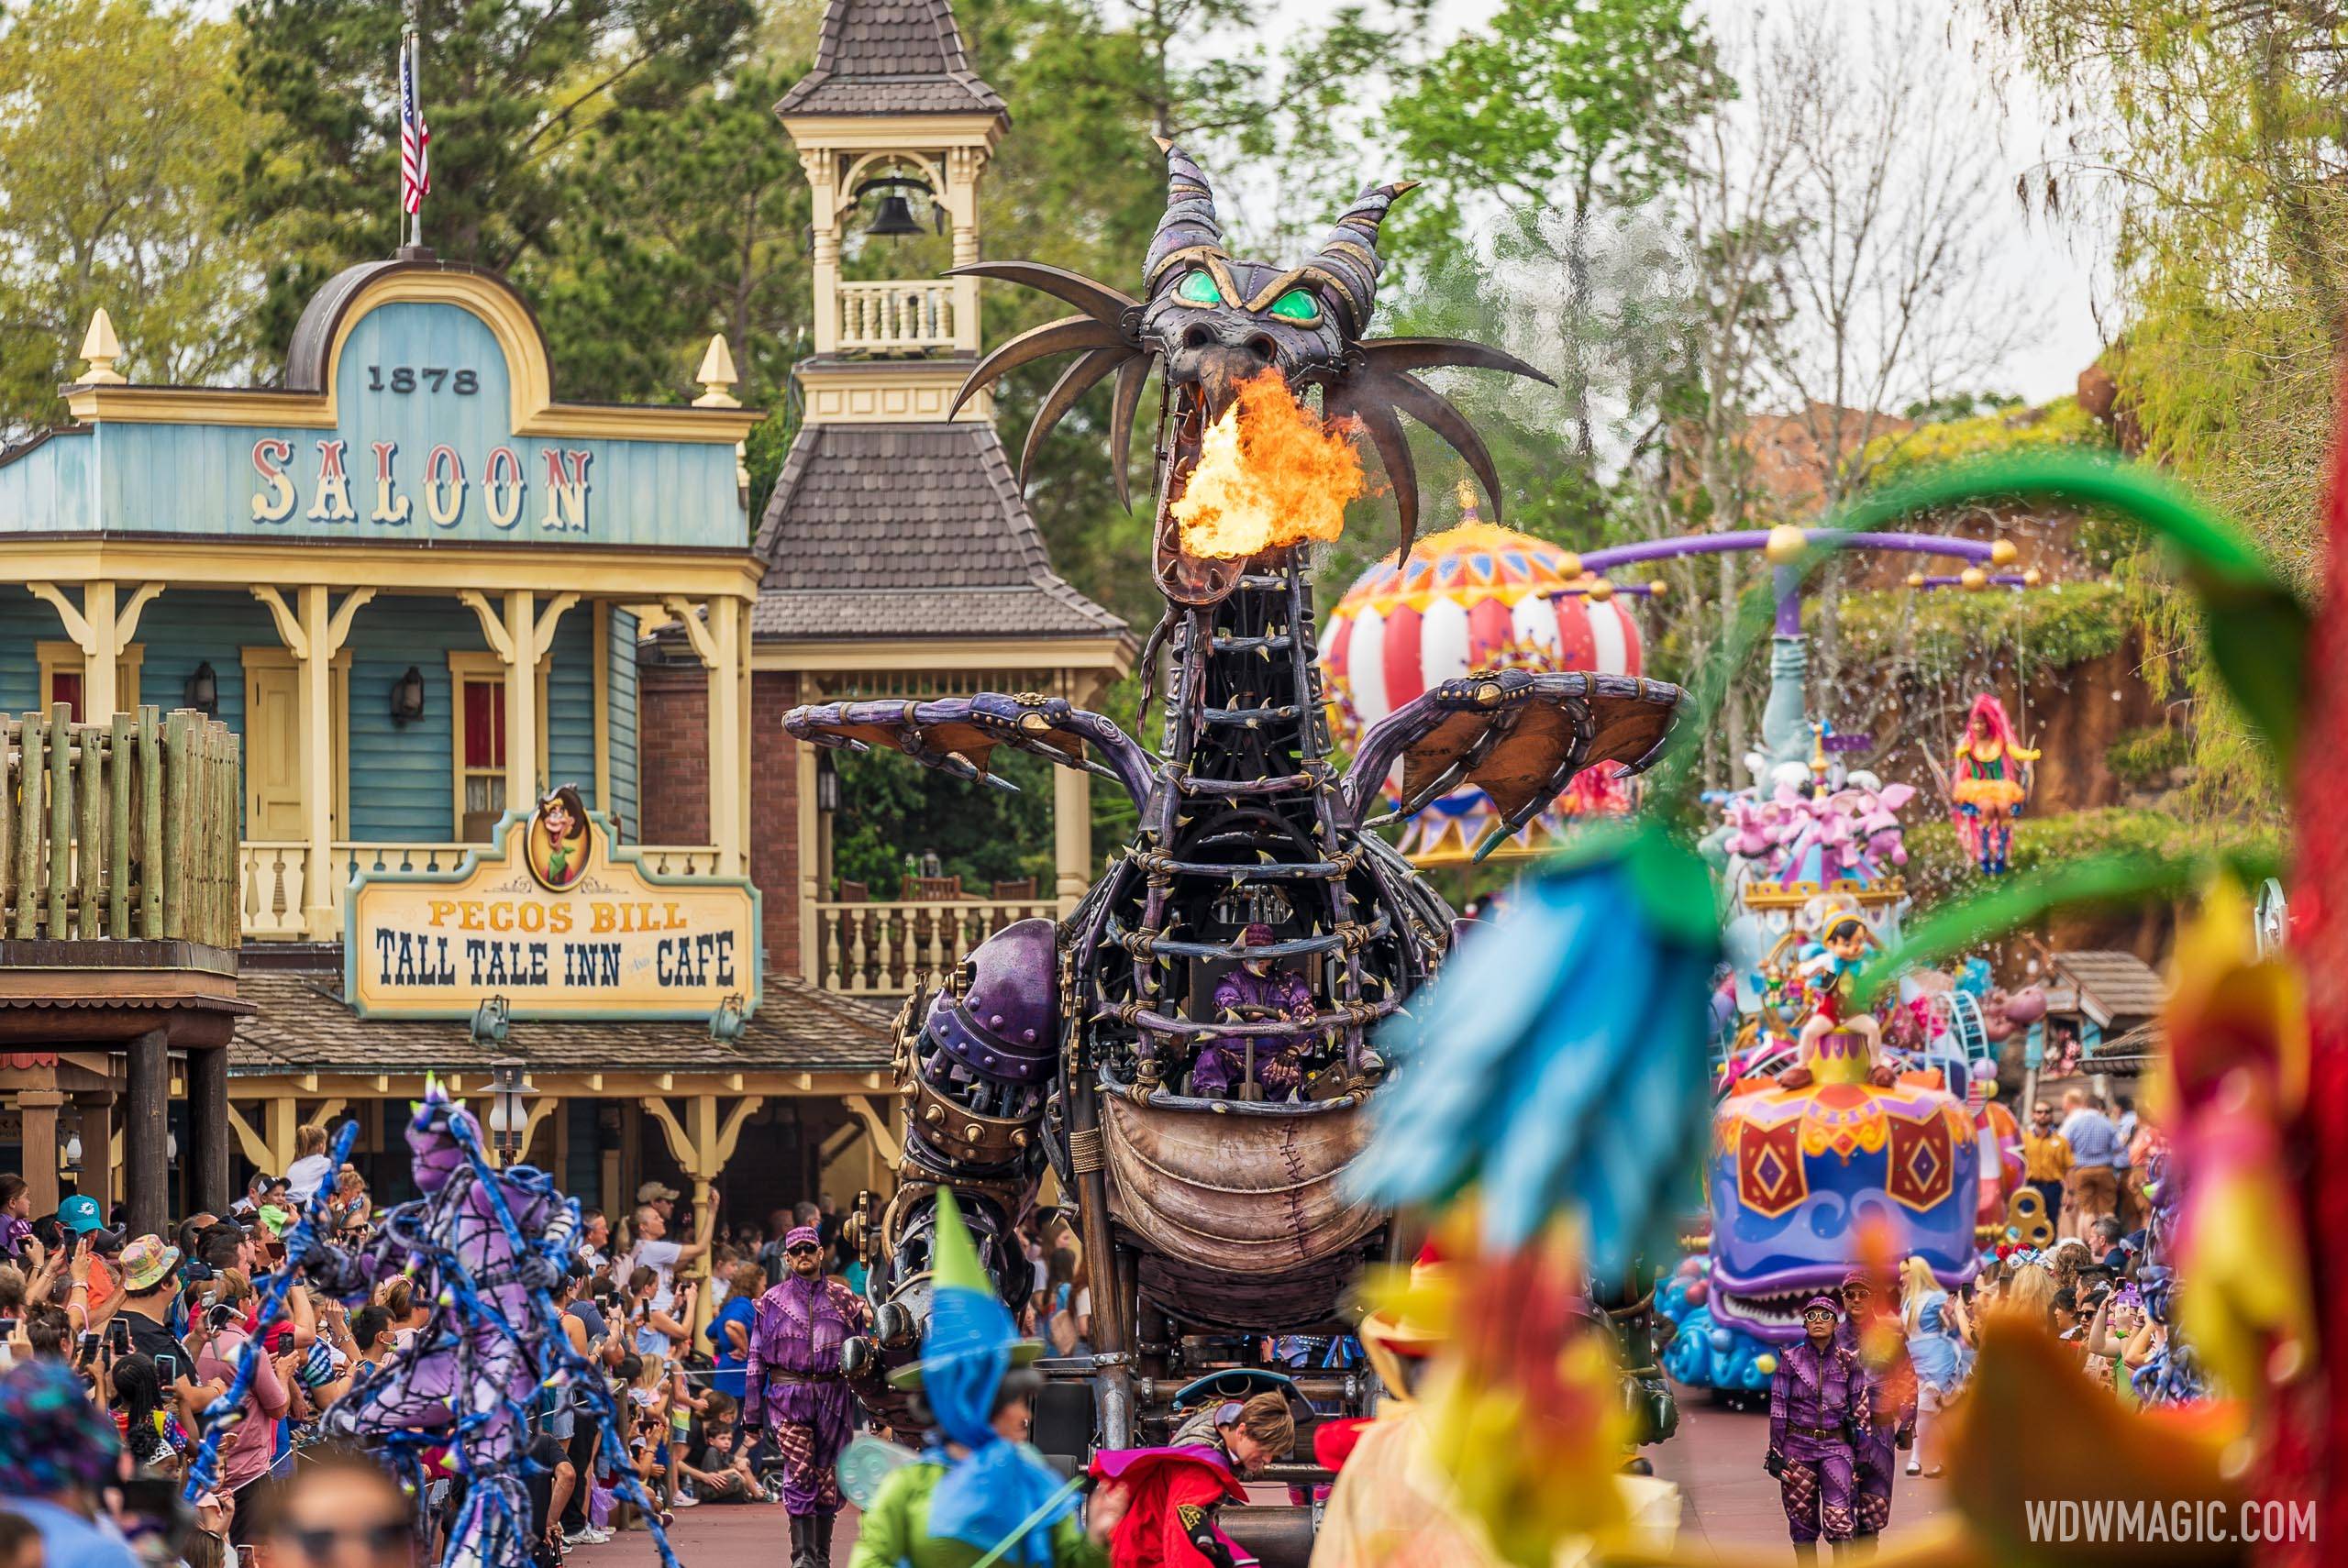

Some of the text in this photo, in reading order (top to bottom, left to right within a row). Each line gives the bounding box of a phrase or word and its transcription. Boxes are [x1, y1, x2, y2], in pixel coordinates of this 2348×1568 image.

[369, 366, 479, 395] 1878
[250, 437, 593, 534] SALOON
[427, 900, 687, 933] PECOS BILL
[376, 928, 456, 987] TALL
[466, 938, 548, 987] TALE
[564, 942, 622, 988] INN
[657, 931, 735, 988] CAFE
